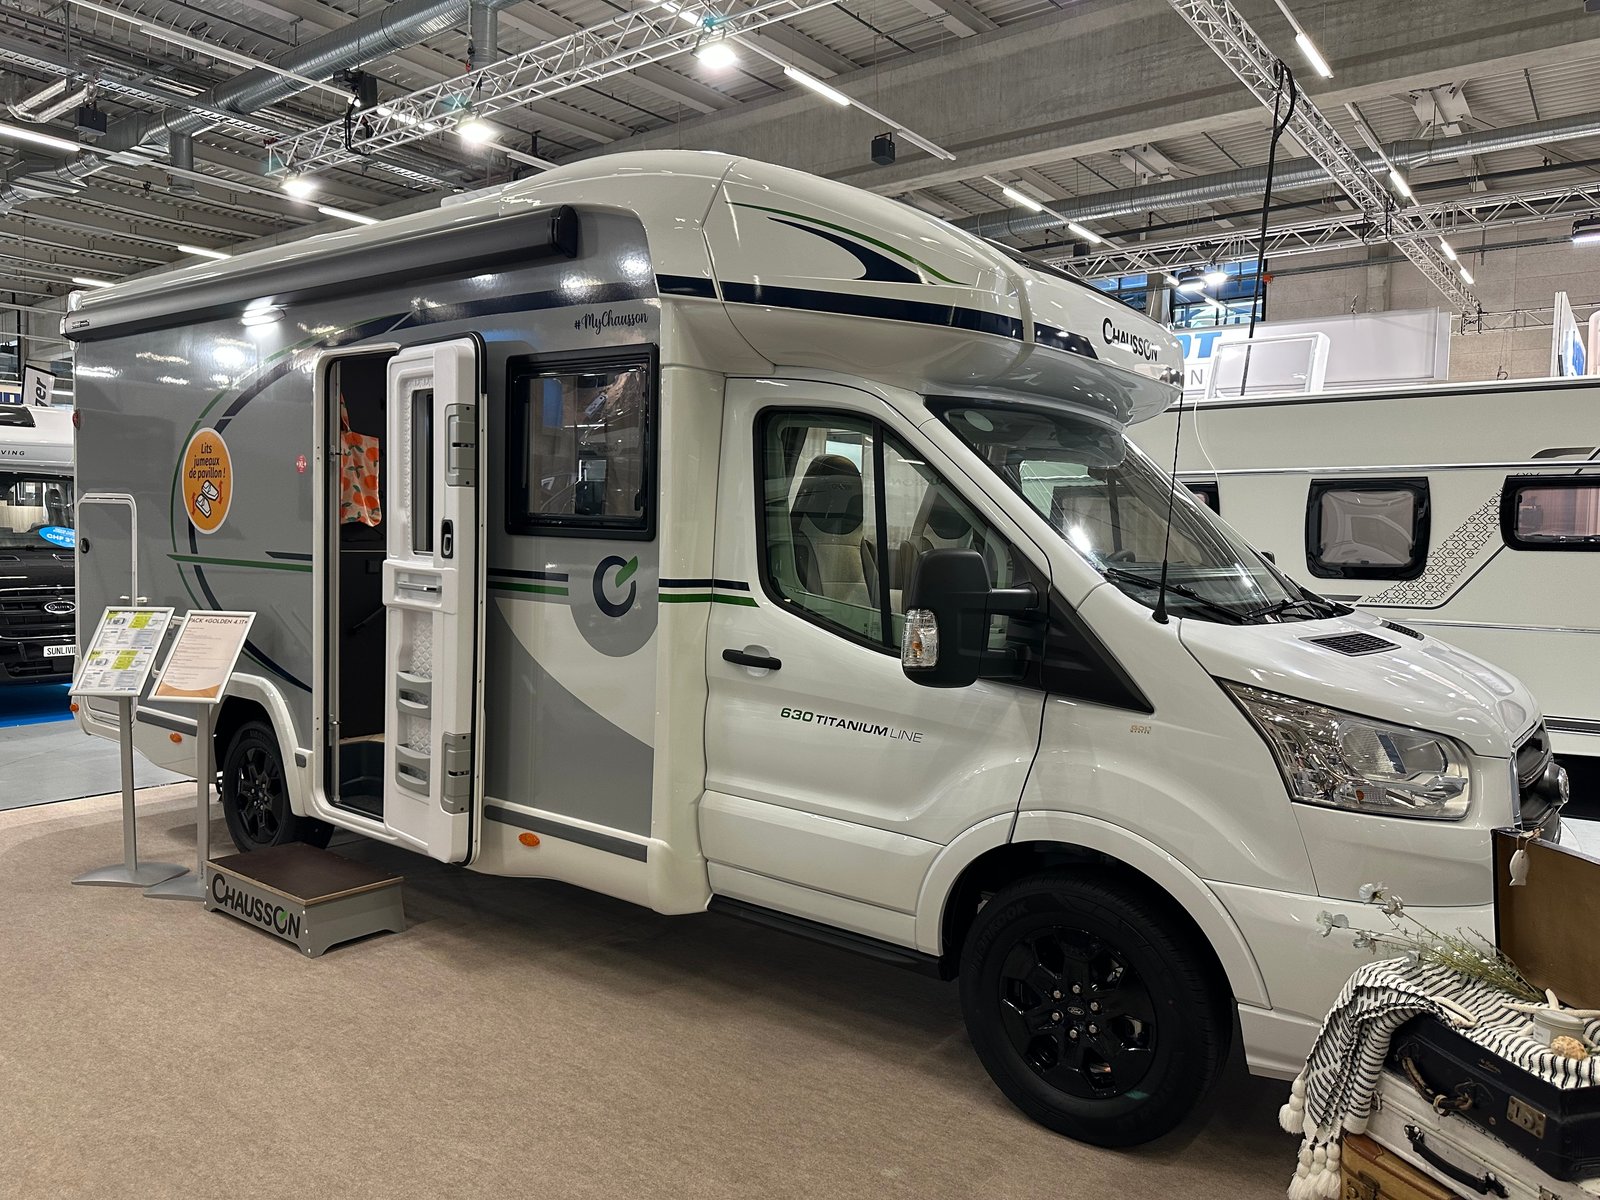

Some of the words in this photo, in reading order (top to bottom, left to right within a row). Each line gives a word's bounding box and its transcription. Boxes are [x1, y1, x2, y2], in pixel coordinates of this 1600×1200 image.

[574, 309, 648, 335] #MyChausson
[201, 442, 212, 454] Lits
[194, 455, 220, 468] jumeaux
[189, 468, 197, 478] de
[198, 467, 222, 480] pavillon
[780, 707, 814, 722] 630
[816, 714, 889, 737] TITANIUM
[889, 728, 924, 744] LINE
[212, 873, 300, 939] CHAUSSON
